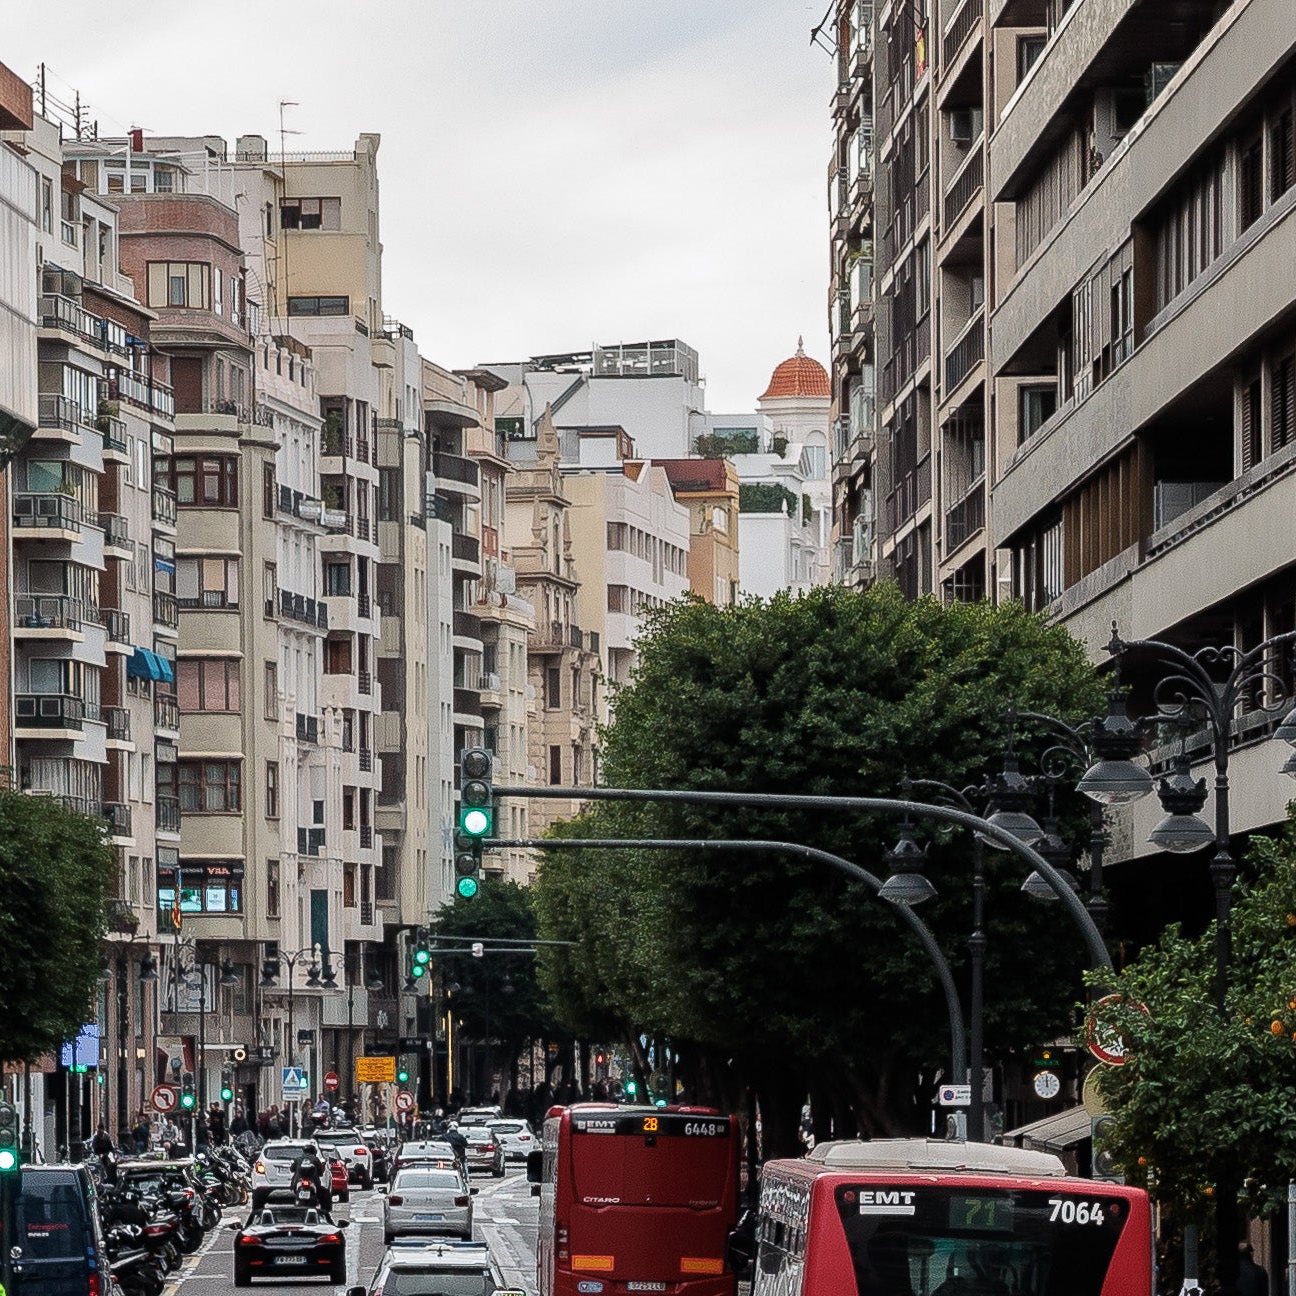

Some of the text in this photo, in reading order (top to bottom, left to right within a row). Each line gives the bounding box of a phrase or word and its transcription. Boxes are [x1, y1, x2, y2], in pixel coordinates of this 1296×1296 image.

[587, 1120, 616, 1128] EMT
[643, 1117, 658, 1131] 28
[684, 1123, 716, 1136] 6448
[859, 1191, 916, 1204] EMT
[965, 1200, 996, 1226] 71
[1048, 1199, 1105, 1226] 7064
